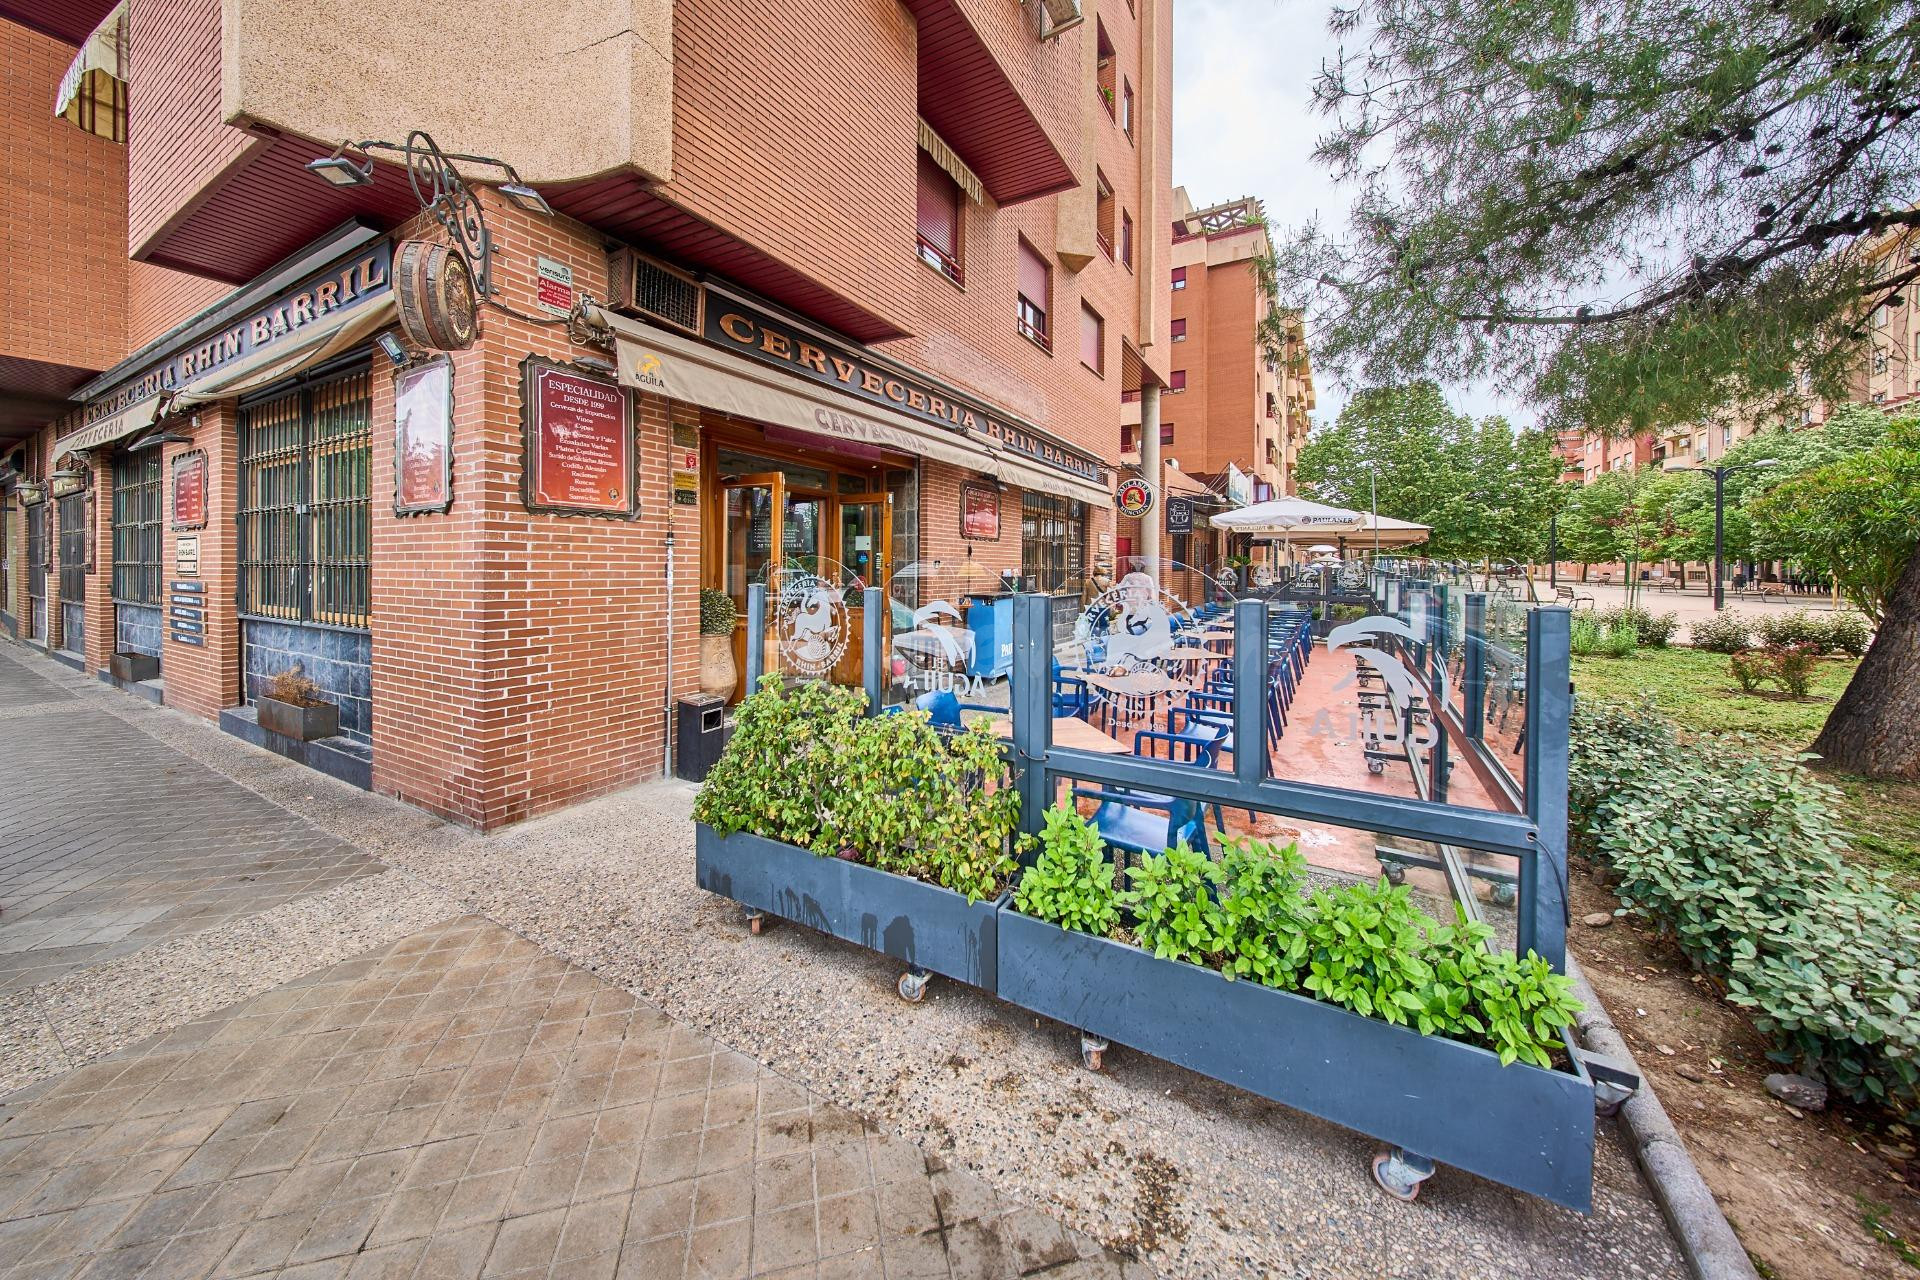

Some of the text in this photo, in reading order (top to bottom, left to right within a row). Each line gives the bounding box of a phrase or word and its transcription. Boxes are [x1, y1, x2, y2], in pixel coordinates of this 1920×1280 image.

[539, 266, 571, 282] verisure
[540, 279, 571, 296] Alarma
[86, 364, 174, 424] CERVECERIA
[181, 326, 244, 378] RHIN
[250, 257, 385, 346] BARRIL
[548, 379, 617, 403] ESPECIALIDAD
[719, 313, 1095, 477] CERVECERIA RHIN BARRIL
[550, 401, 577, 412] Cervezas
[563, 394, 605, 410] DESDE 1999
[576, 415, 593, 424] Vinos
[575, 423, 594, 432] Copas
[560, 437, 609, 451] Ensaladas Varias
[555, 445, 613, 459] Platos Combinados
[561, 461, 584, 470] Codillo
[571, 470, 598, 479] Raciones
[569, 485, 600, 493] Bocadillos
[1117, 480, 1151, 497] PAULANER
[820, 642, 844, 669] BARRIL
[1108, 718, 1139, 728] Desde
